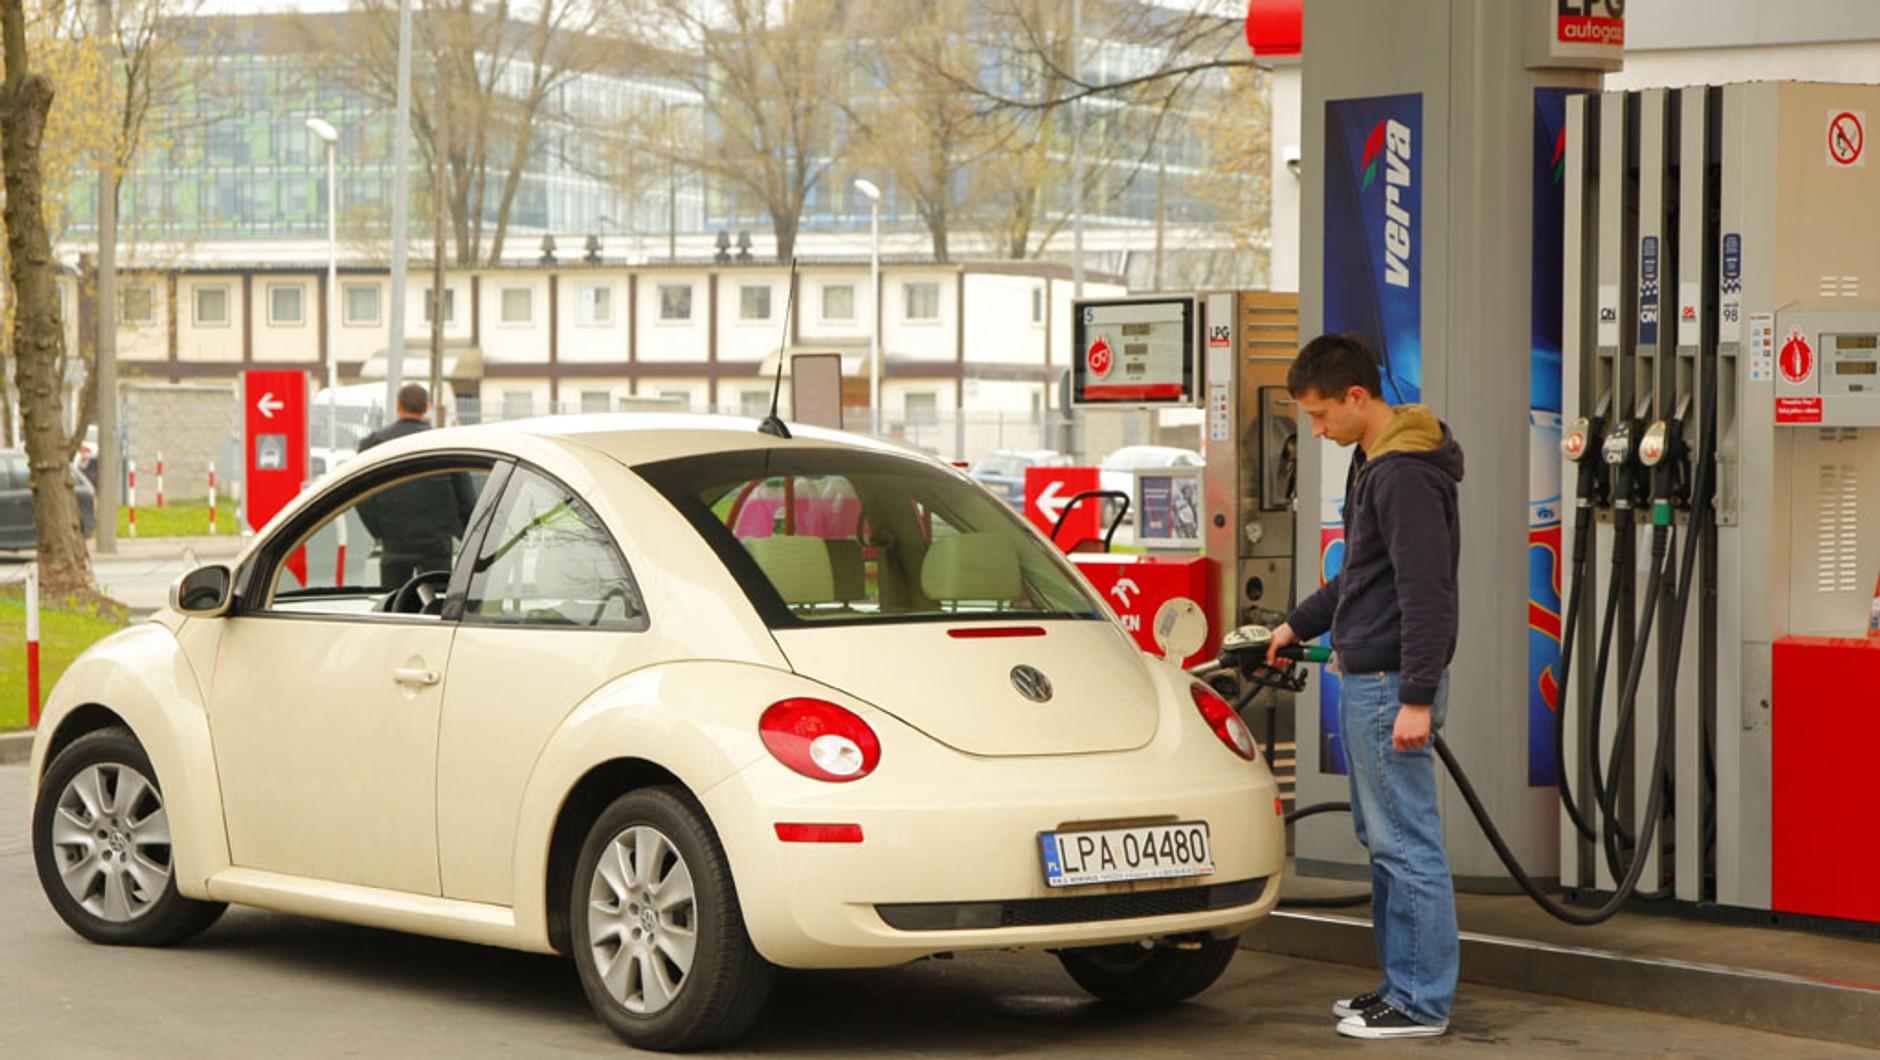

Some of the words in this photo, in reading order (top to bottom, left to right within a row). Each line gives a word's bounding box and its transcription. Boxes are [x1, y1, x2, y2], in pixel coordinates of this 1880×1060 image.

[1385, 118, 1411, 288] verva
[1086, 311, 1094, 322] 5
[1723, 308, 1738, 322] 98
[1210, 325, 1230, 339] LPG
[1059, 834, 1117, 873] LPA
[1123, 828, 1206, 868] 04480
